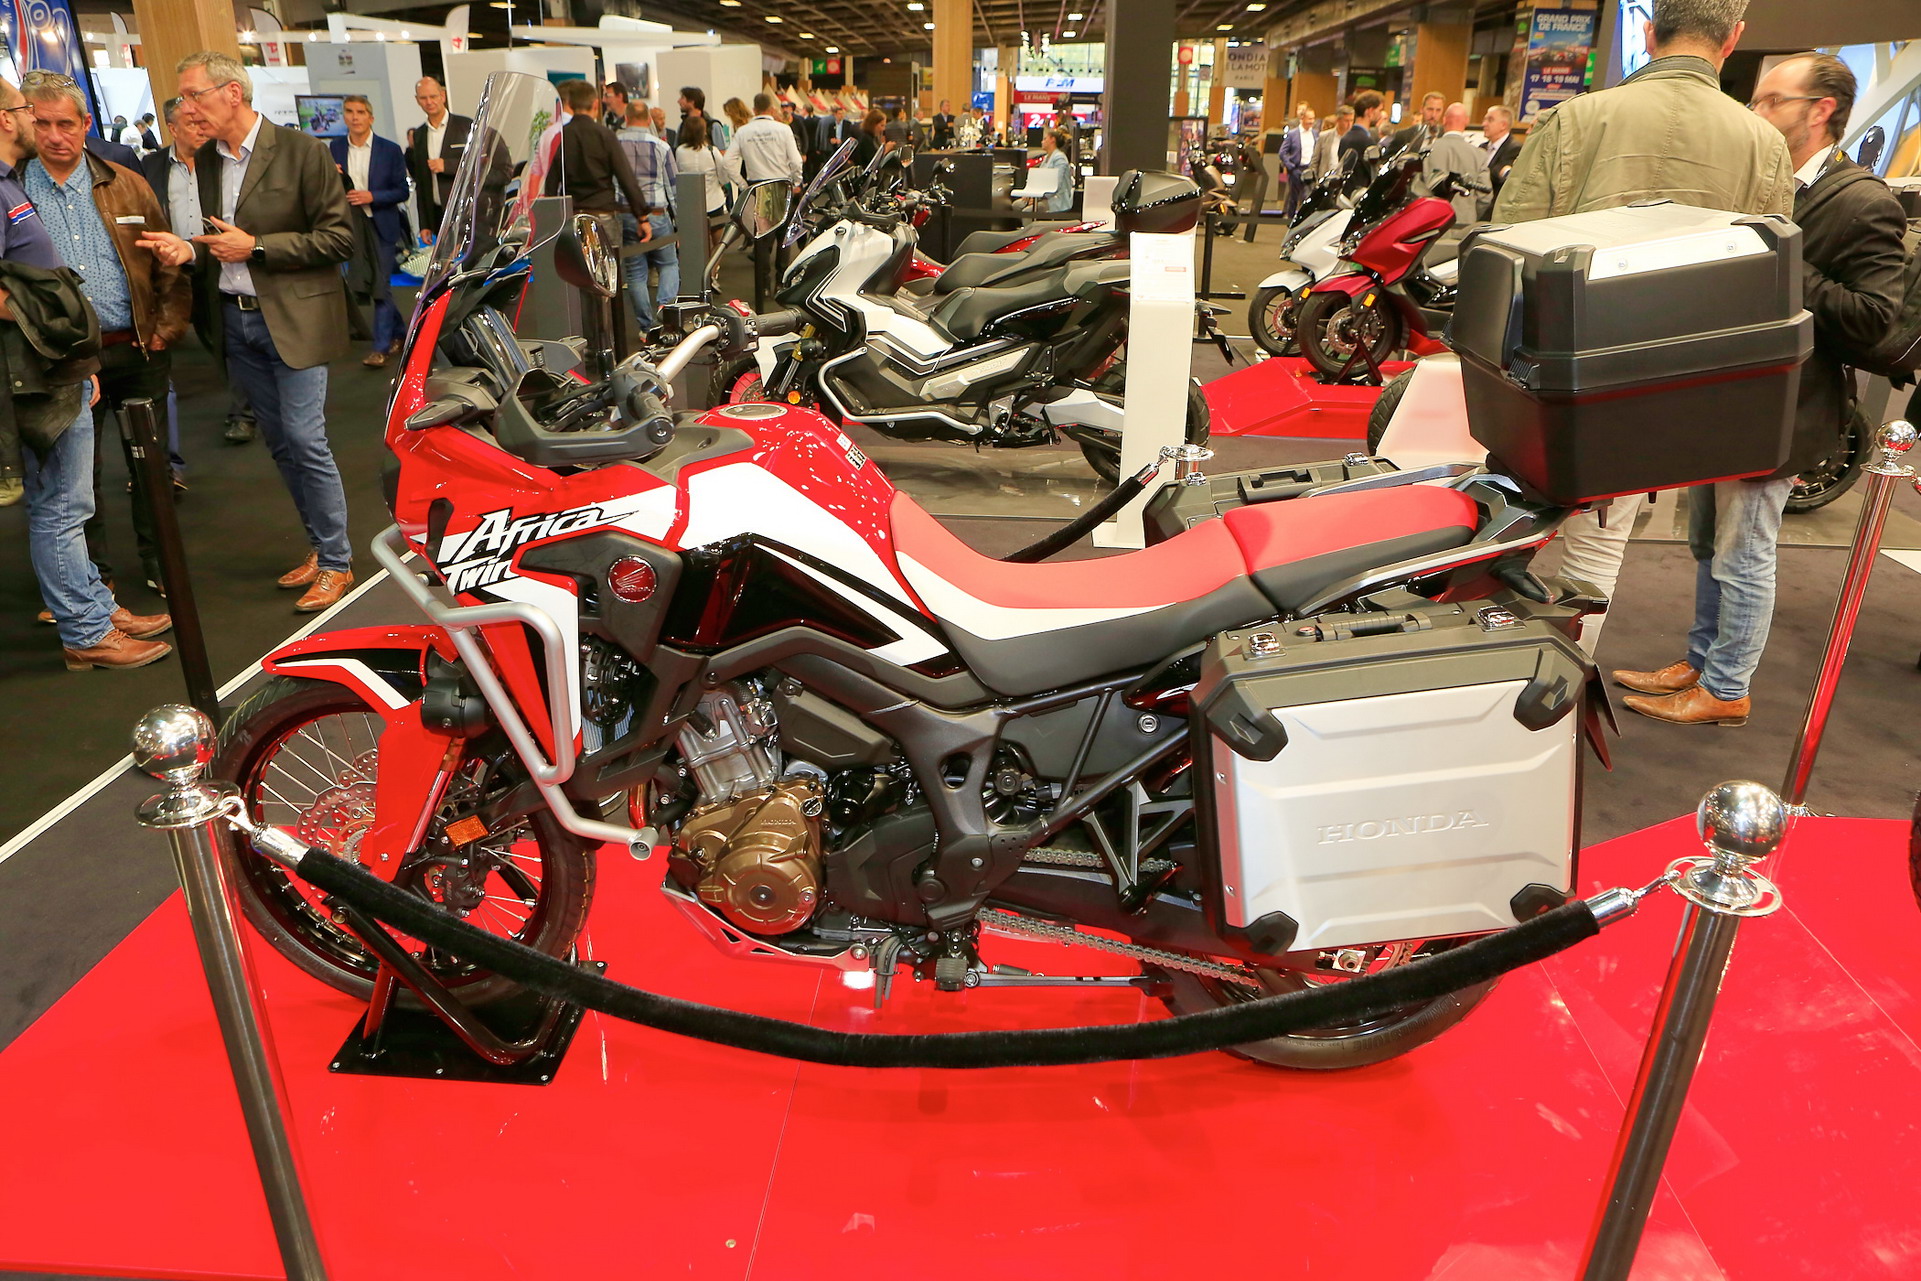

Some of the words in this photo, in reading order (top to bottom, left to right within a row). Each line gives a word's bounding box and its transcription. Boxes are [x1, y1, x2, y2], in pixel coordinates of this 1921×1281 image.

[1536, 14, 1568, 24] GRAND
[1570, 15, 1591, 24] PRIX
[1228, 53, 1266, 61] ONDIA
[1245, 63, 1266, 71] MOT
[1530, 74, 1540, 82] 17
[1565, 75, 1579, 83] MAI
[448, 506, 641, 562] Africa
[440, 556, 521, 597] Twin
[1317, 808, 1490, 846] HONDA
